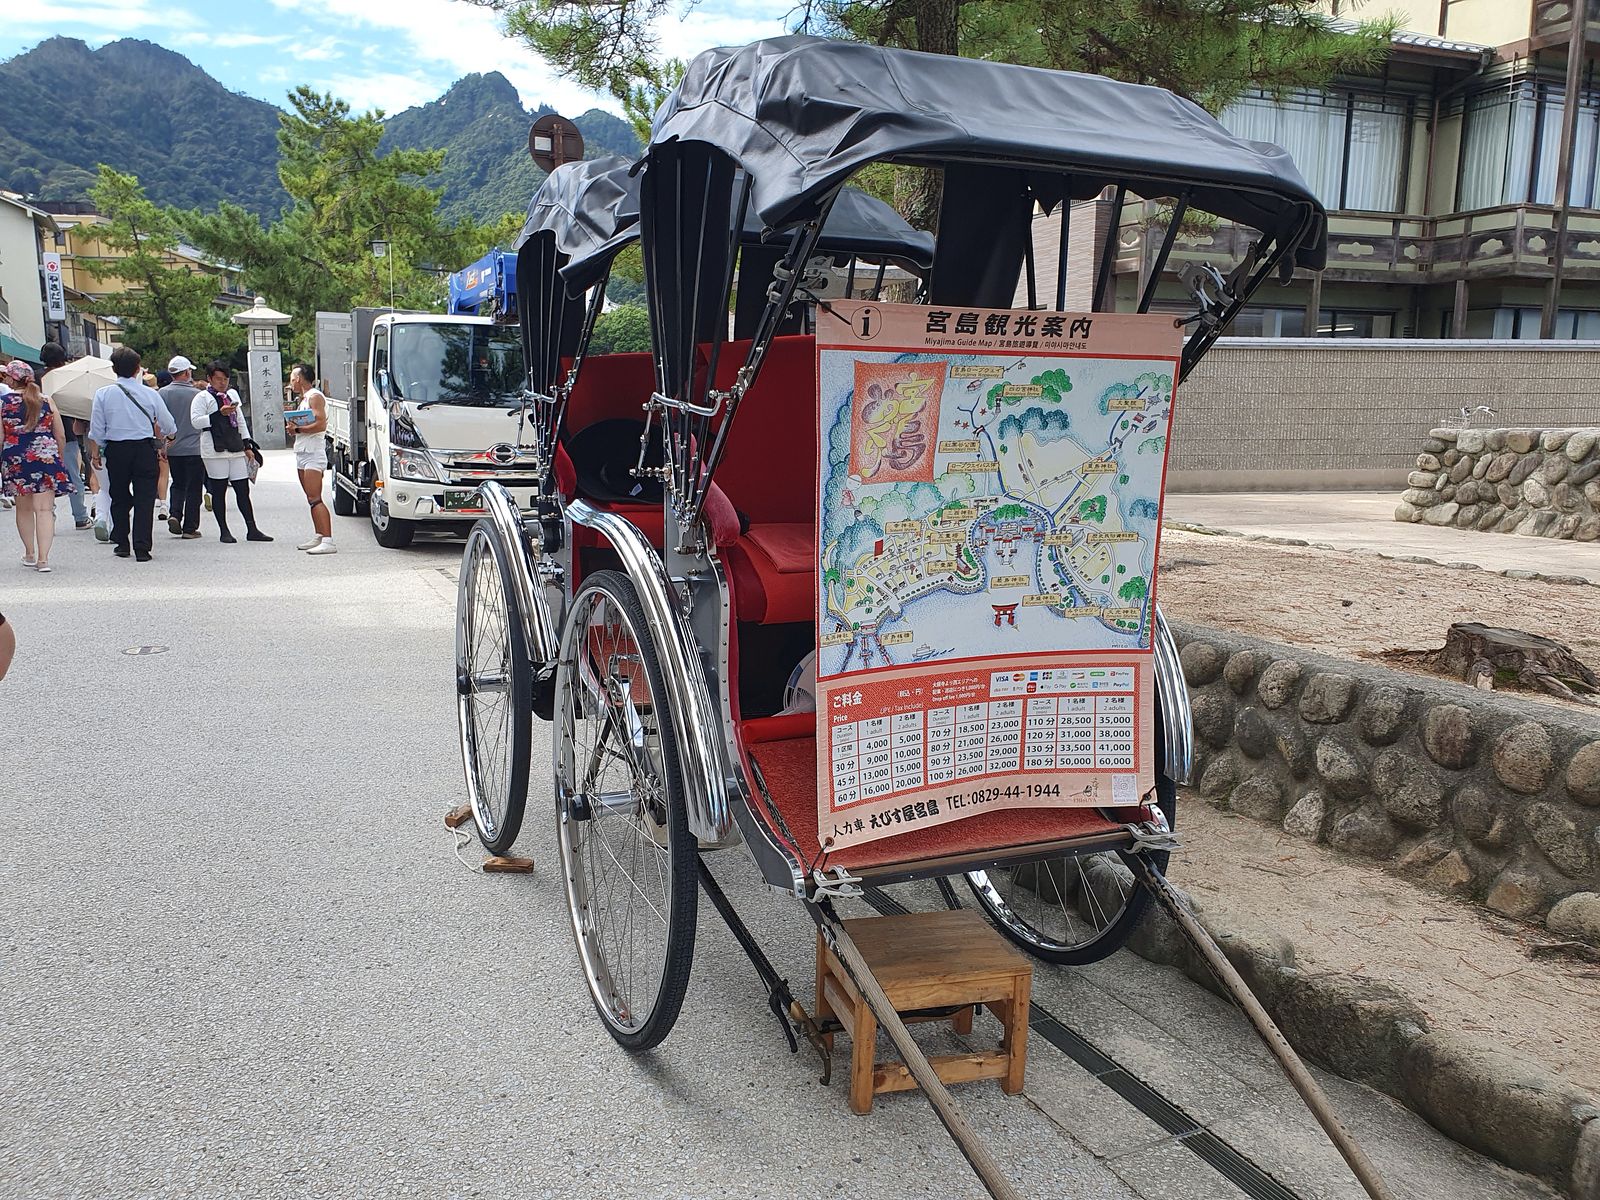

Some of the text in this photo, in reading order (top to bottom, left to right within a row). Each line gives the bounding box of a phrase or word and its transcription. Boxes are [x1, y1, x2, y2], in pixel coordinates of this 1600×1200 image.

[925, 310, 1093, 339] 宮島観光案内
[925, 338, 955, 346] Miyajima
[978, 340, 992, 348] Map
[833, 690, 863, 708] ご料金
[833, 714, 848, 723] Price
[1061, 717, 1091, 725] 28,500
[837, 725, 853, 733] コース
[959, 724, 984, 733] 18,500
[992, 720, 1019, 730] 23,000
[900, 733, 920, 743] 5,000
[991, 733, 1018, 743] 26,000
[1061, 730, 1091, 738] 31,000
[1099, 730, 1130, 738] 38,000
[866, 739, 888, 750] 4,000
[958, 737, 984, 747] 21,000
[895, 747, 920, 759] 10,000
[990, 747, 1017, 756] 29,000
[1060, 744, 1091, 752] 33,500
[1099, 744, 1130, 752] 41,000
[867, 754, 888, 765] 9,000
[958, 751, 983, 761] 23,500
[990, 760, 1016, 770] 32,000
[1060, 758, 1091, 766] 50,000
[1099, 758, 1131, 766] 60,000
[895, 762, 921, 773] 15,000
[957, 764, 983, 776] 26,000
[863, 768, 889, 780] 13,000
[896, 776, 921, 788] 20,000
[864, 783, 890, 795] 16,000
[833, 818, 866, 838] 人力車
[869, 799, 940, 830] えびす屋宮島
[945, 784, 1060, 810] TEL:0829-44-1944
